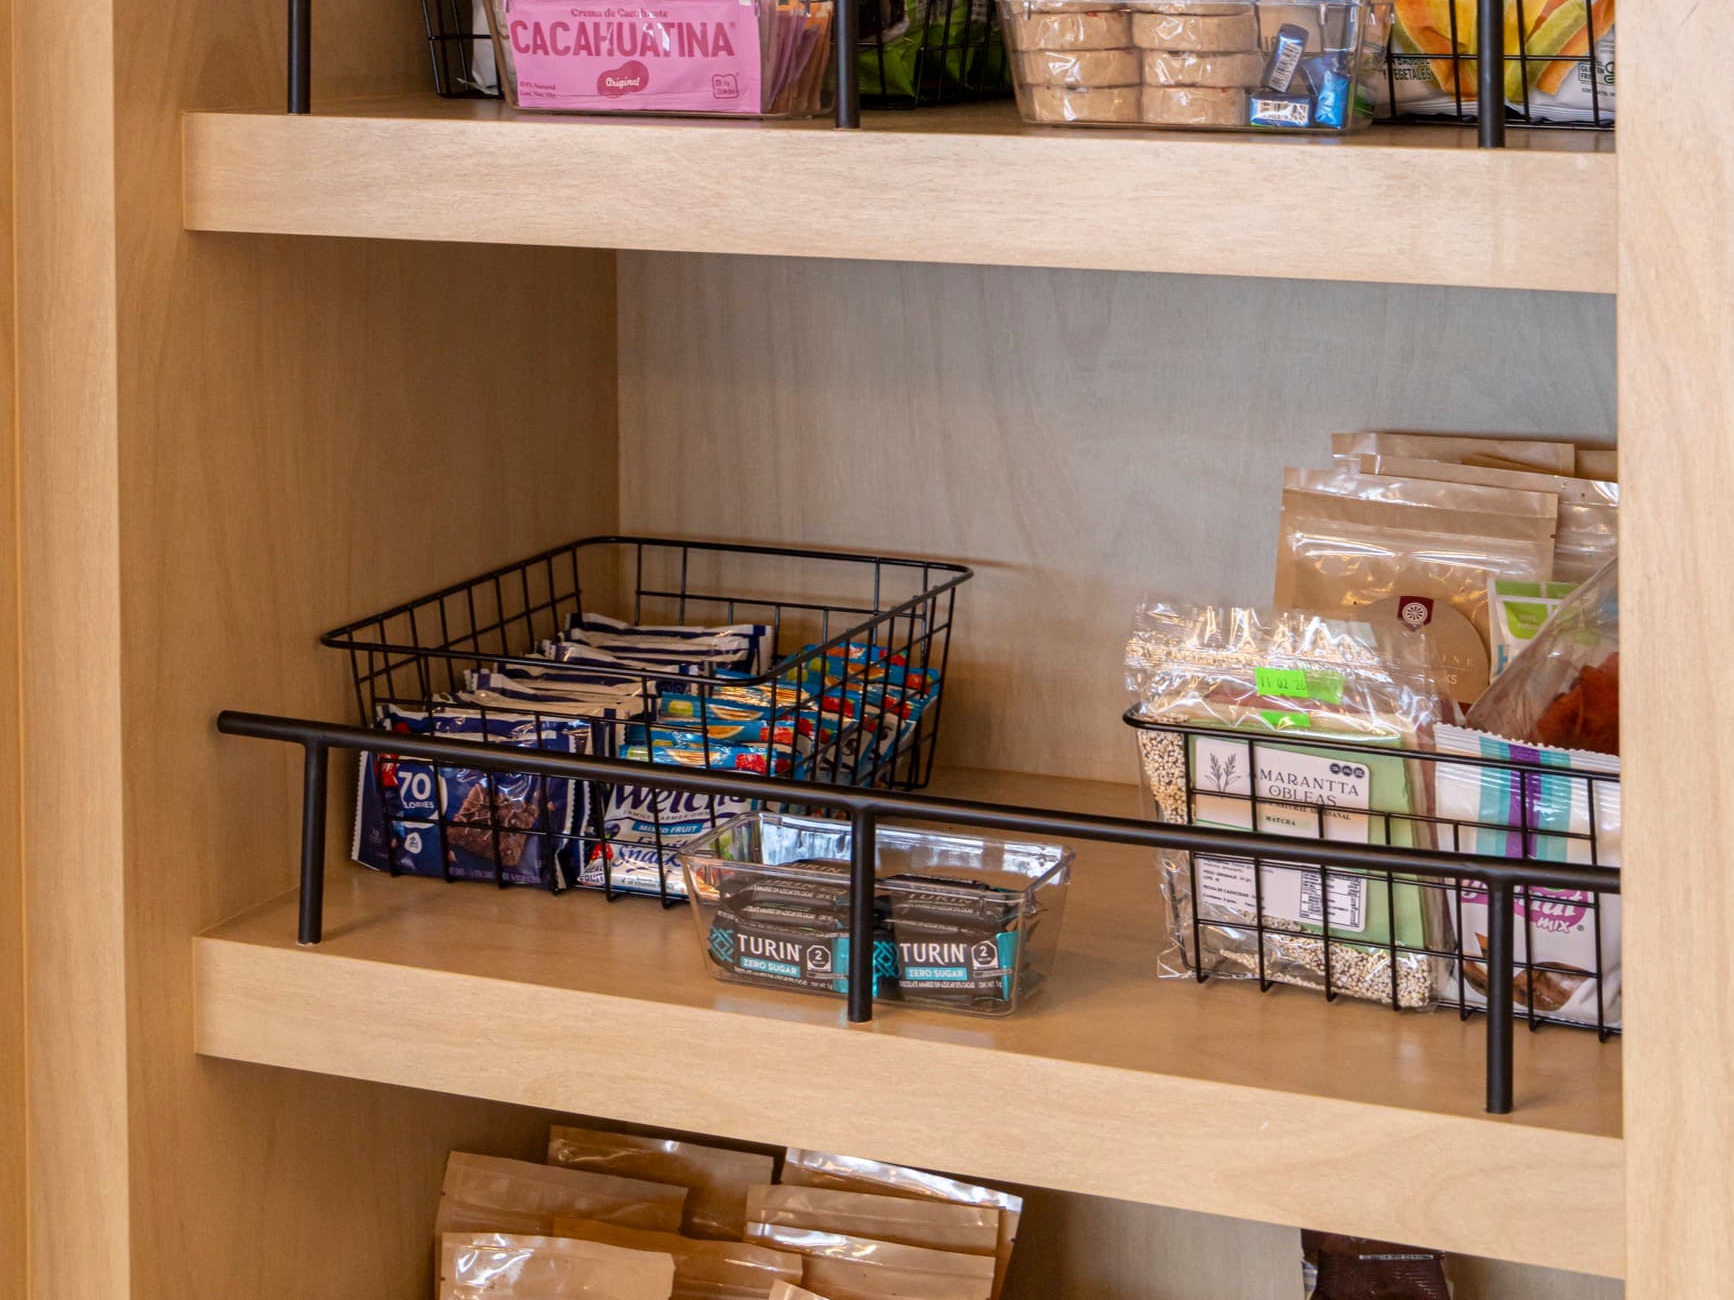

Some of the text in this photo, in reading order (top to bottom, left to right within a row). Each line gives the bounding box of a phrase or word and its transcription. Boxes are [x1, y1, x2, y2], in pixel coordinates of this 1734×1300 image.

[571, 8, 602, 18] Crema
[604, 8, 616, 18] de
[510, 19, 736, 58] CACAHUATINA
[605, 77, 641, 89] Original
[397, 771, 431, 801] 70
[1248, 767, 1360, 797] MARANTTA
[1268, 784, 1338, 806] OBLEAS
[1265, 815, 1297, 826] MATCHA
[670, 825, 698, 835] FRUIT
[737, 933, 801, 962] TURIN
[814, 949, 823, 961] 2
[900, 943, 965, 965] TURIN
[978, 946, 989, 958] 2
[743, 957, 798, 976] ZERO SUGAR
[909, 968, 964, 978] ZERO SUGAR
